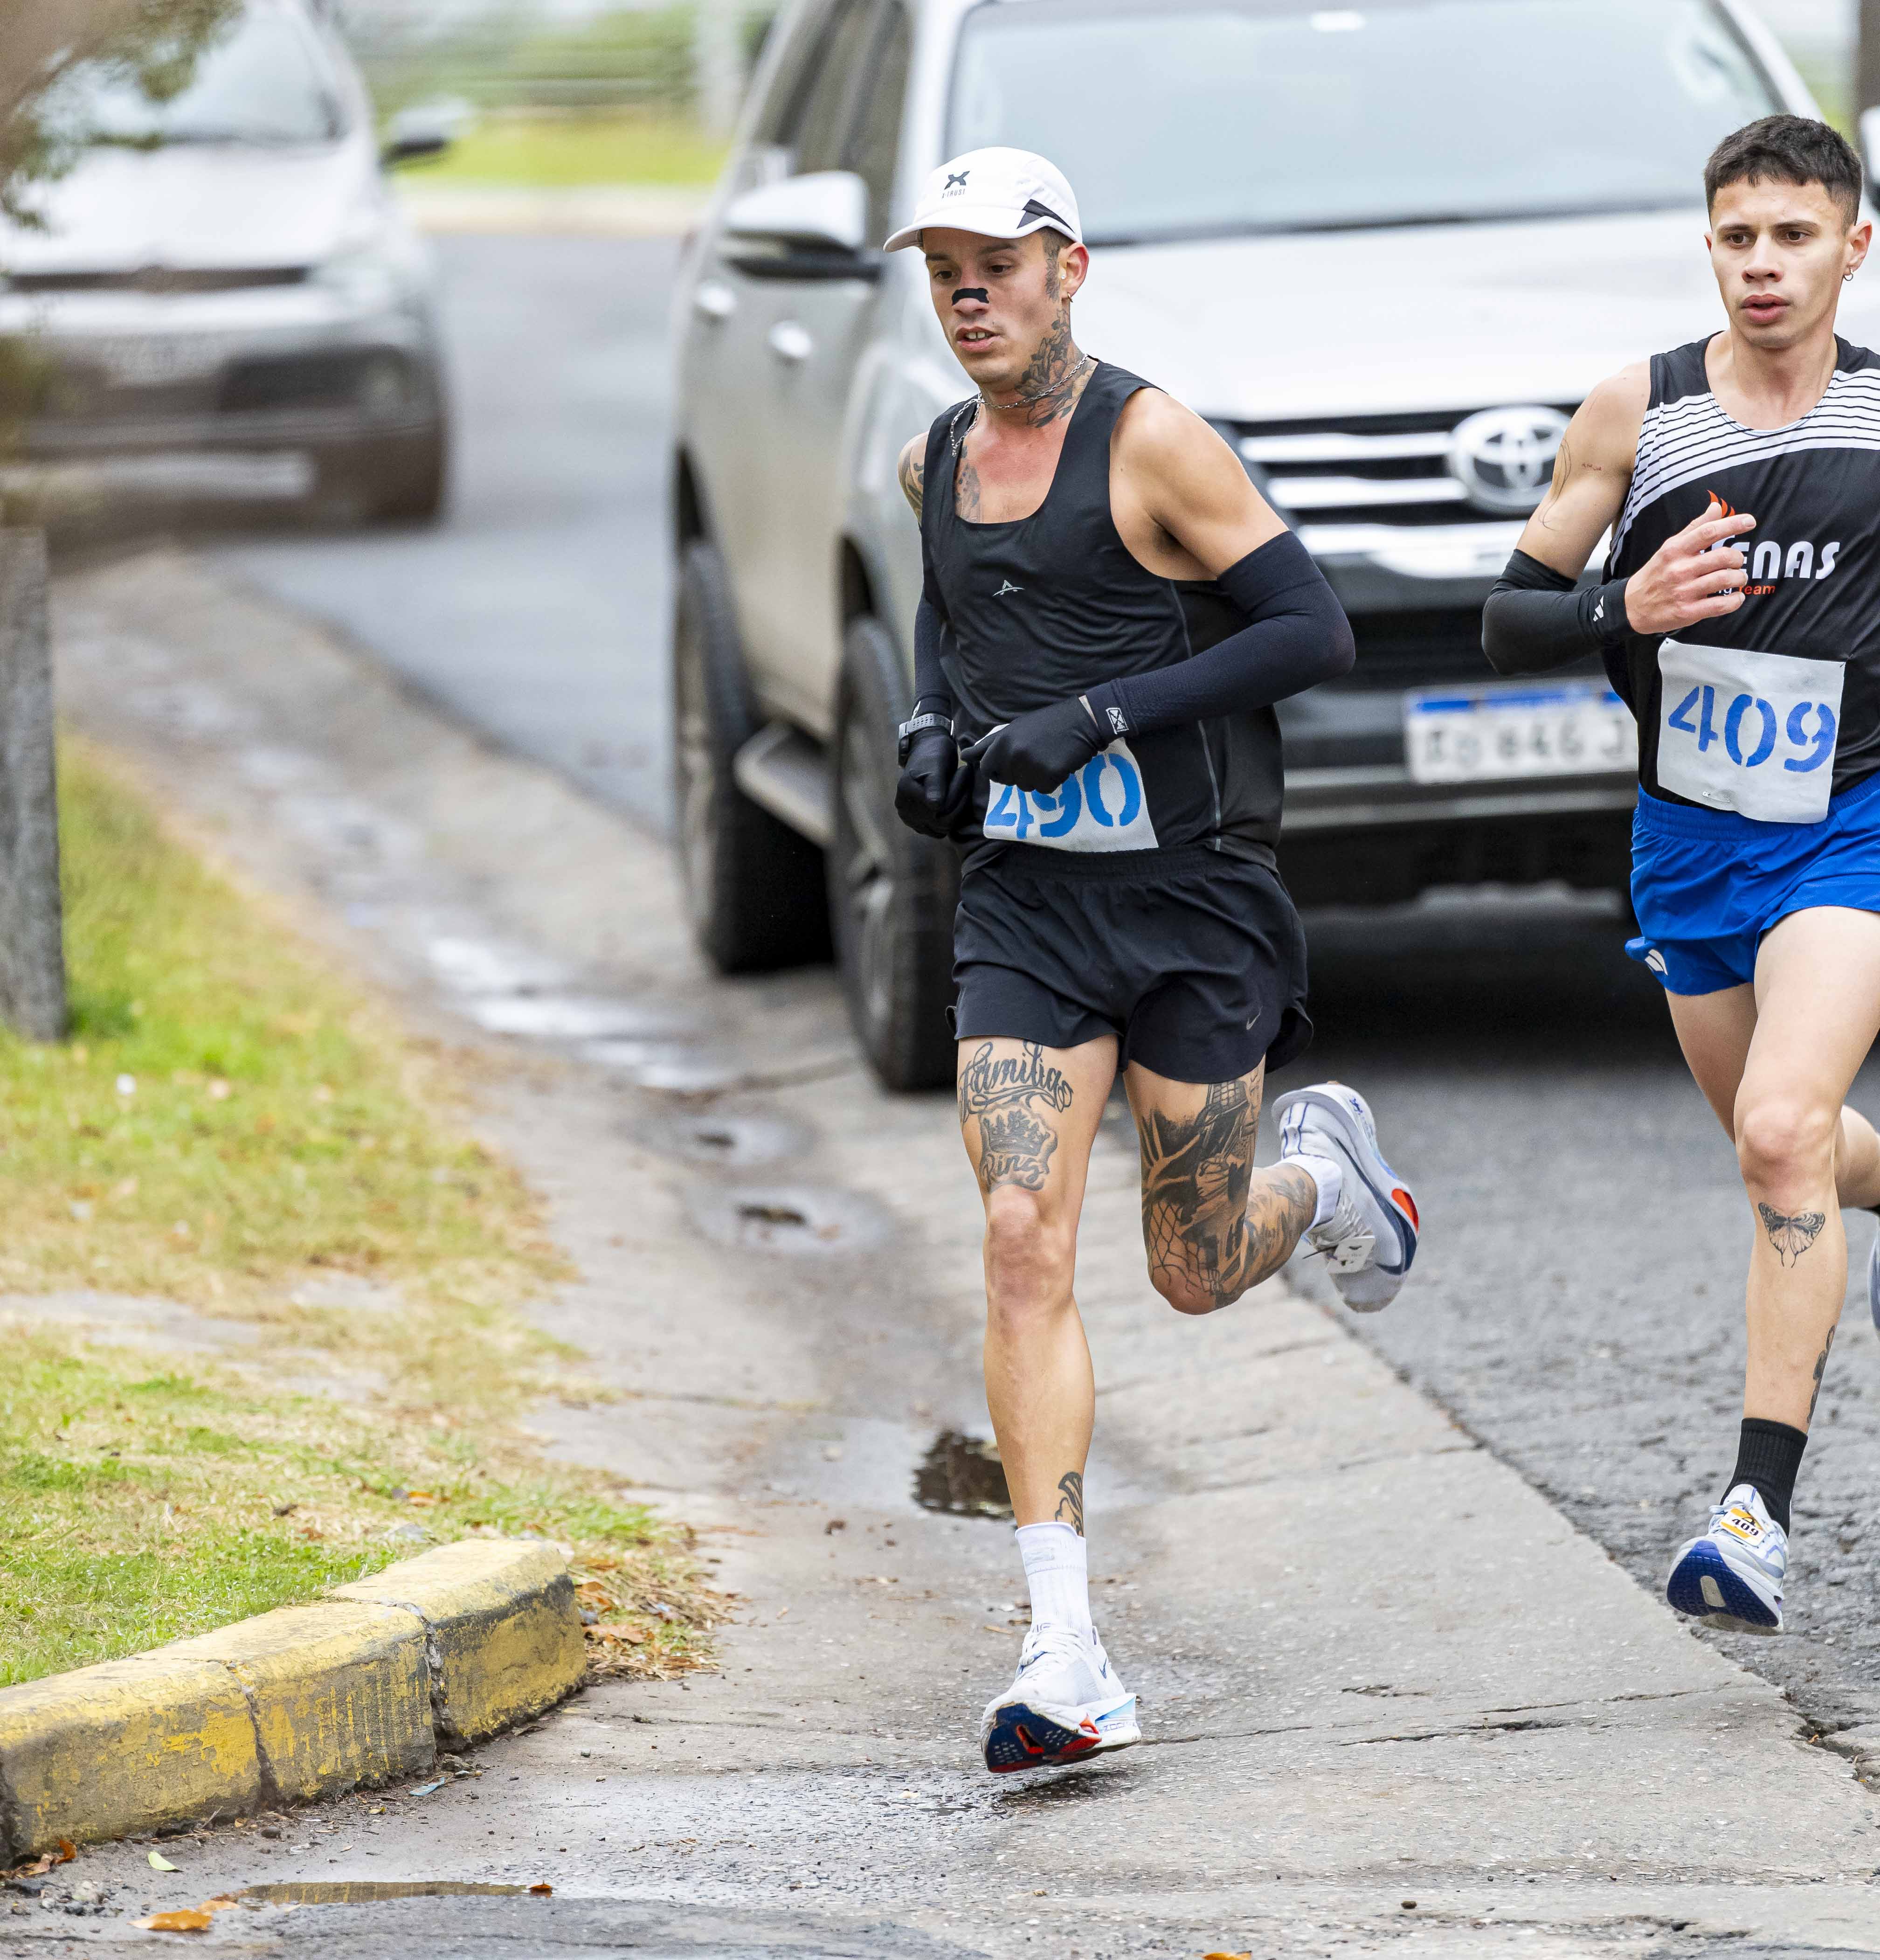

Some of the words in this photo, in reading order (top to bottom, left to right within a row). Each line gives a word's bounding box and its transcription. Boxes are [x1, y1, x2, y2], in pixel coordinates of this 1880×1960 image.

[1668, 685, 1836, 772] 409
[986, 753, 1140, 839] 490
[1732, 1519, 1759, 1536] 409
